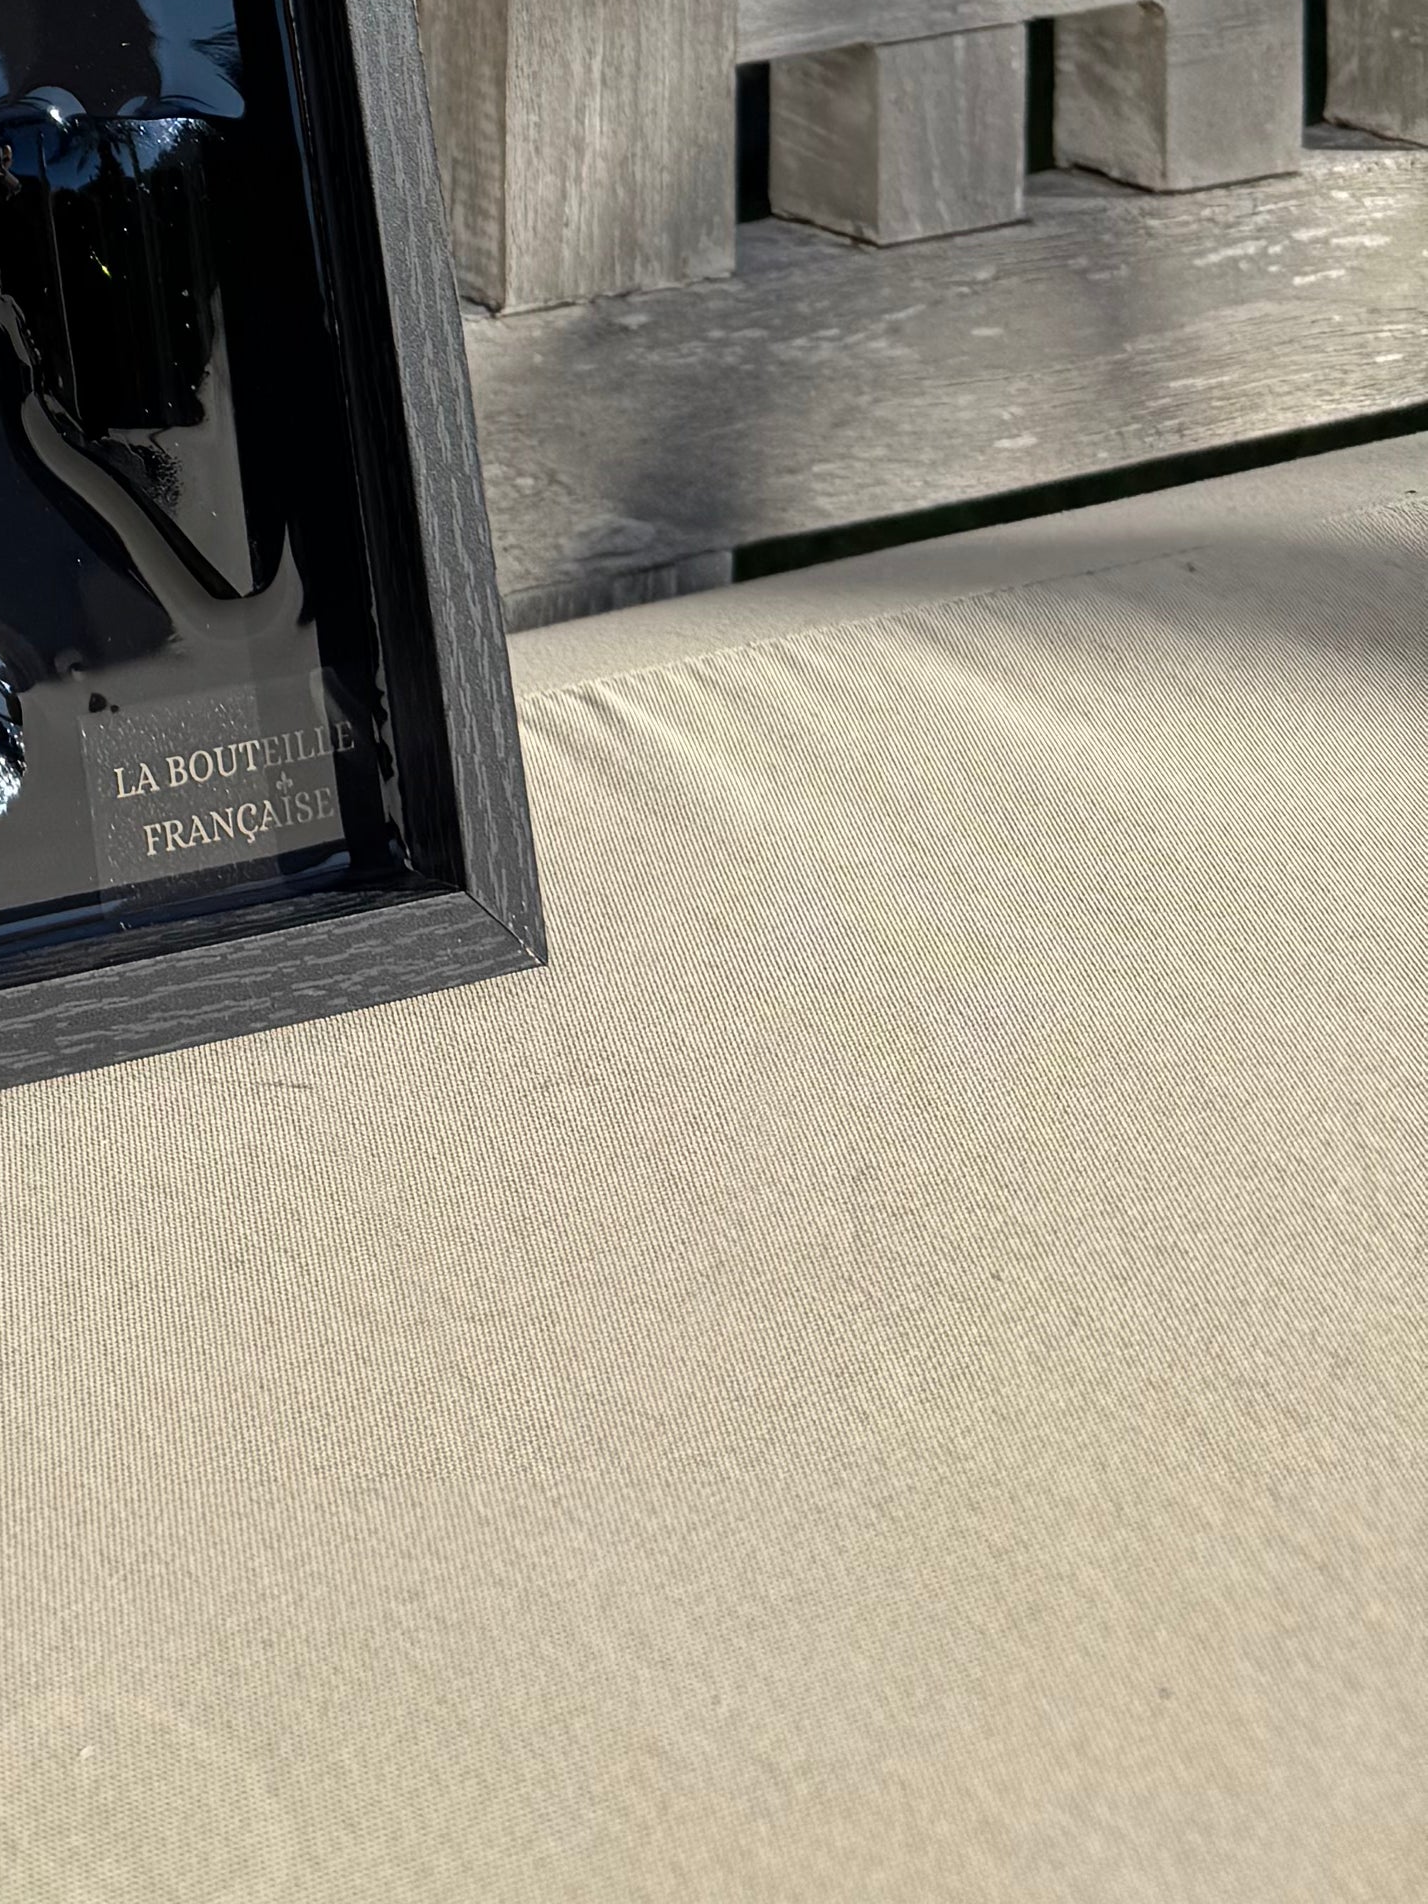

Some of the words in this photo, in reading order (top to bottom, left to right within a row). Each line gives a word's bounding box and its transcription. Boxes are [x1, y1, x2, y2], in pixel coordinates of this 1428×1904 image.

[112, 763, 160, 800] LA
[164, 720, 355, 787] BOUTEILLE
[143, 786, 335, 857] FRANÇAISE
